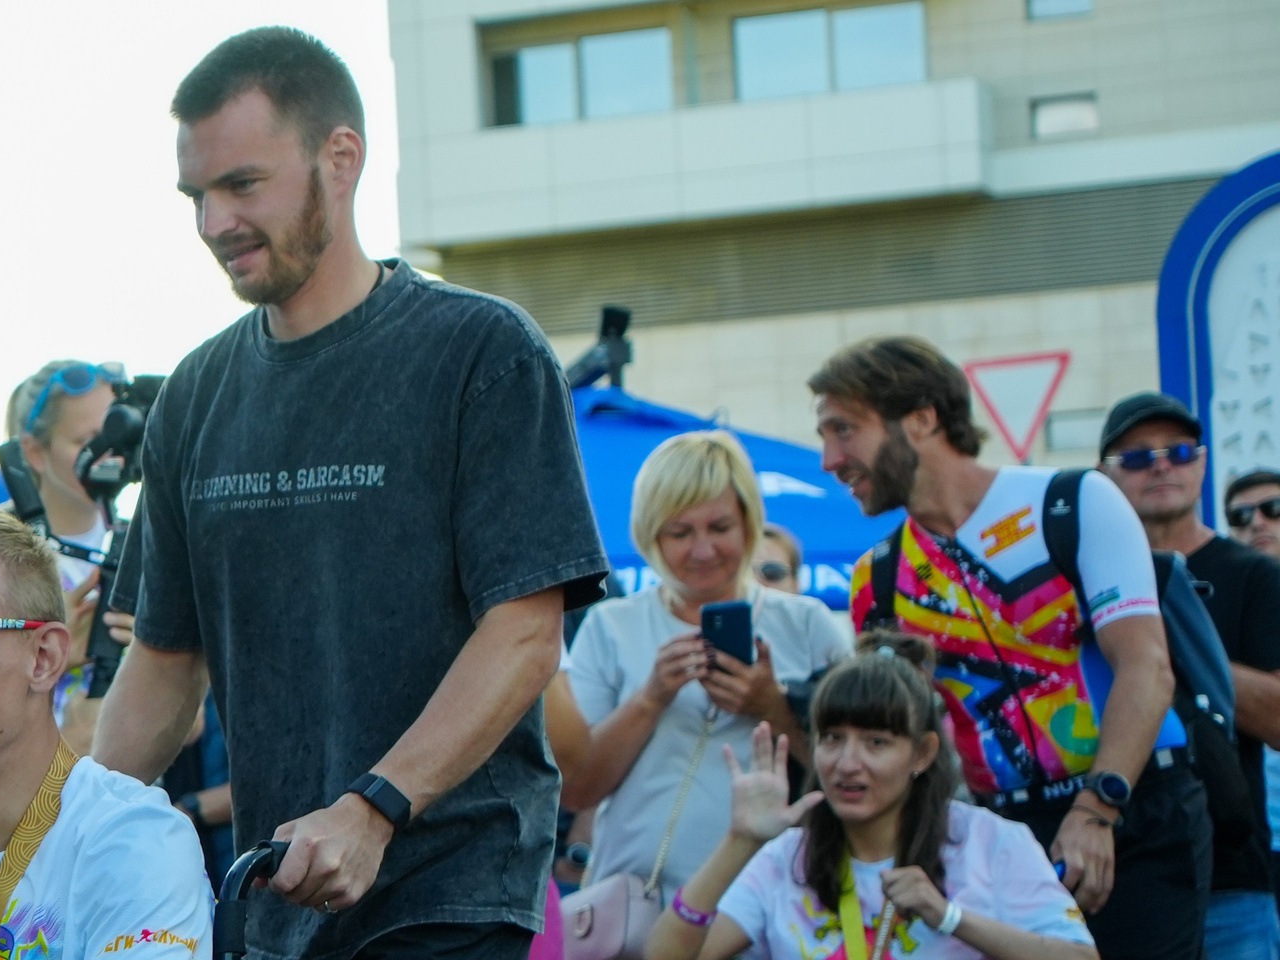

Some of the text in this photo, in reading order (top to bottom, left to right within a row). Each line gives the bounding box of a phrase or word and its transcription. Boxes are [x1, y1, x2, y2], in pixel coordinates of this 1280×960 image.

[276, 471, 293, 493] &
[297, 464, 386, 490] SARCASM
[230, 498, 290, 510] IMPORTANT
[294, 494, 321, 506] SKILLS
[330, 491, 358, 502] HAVE
